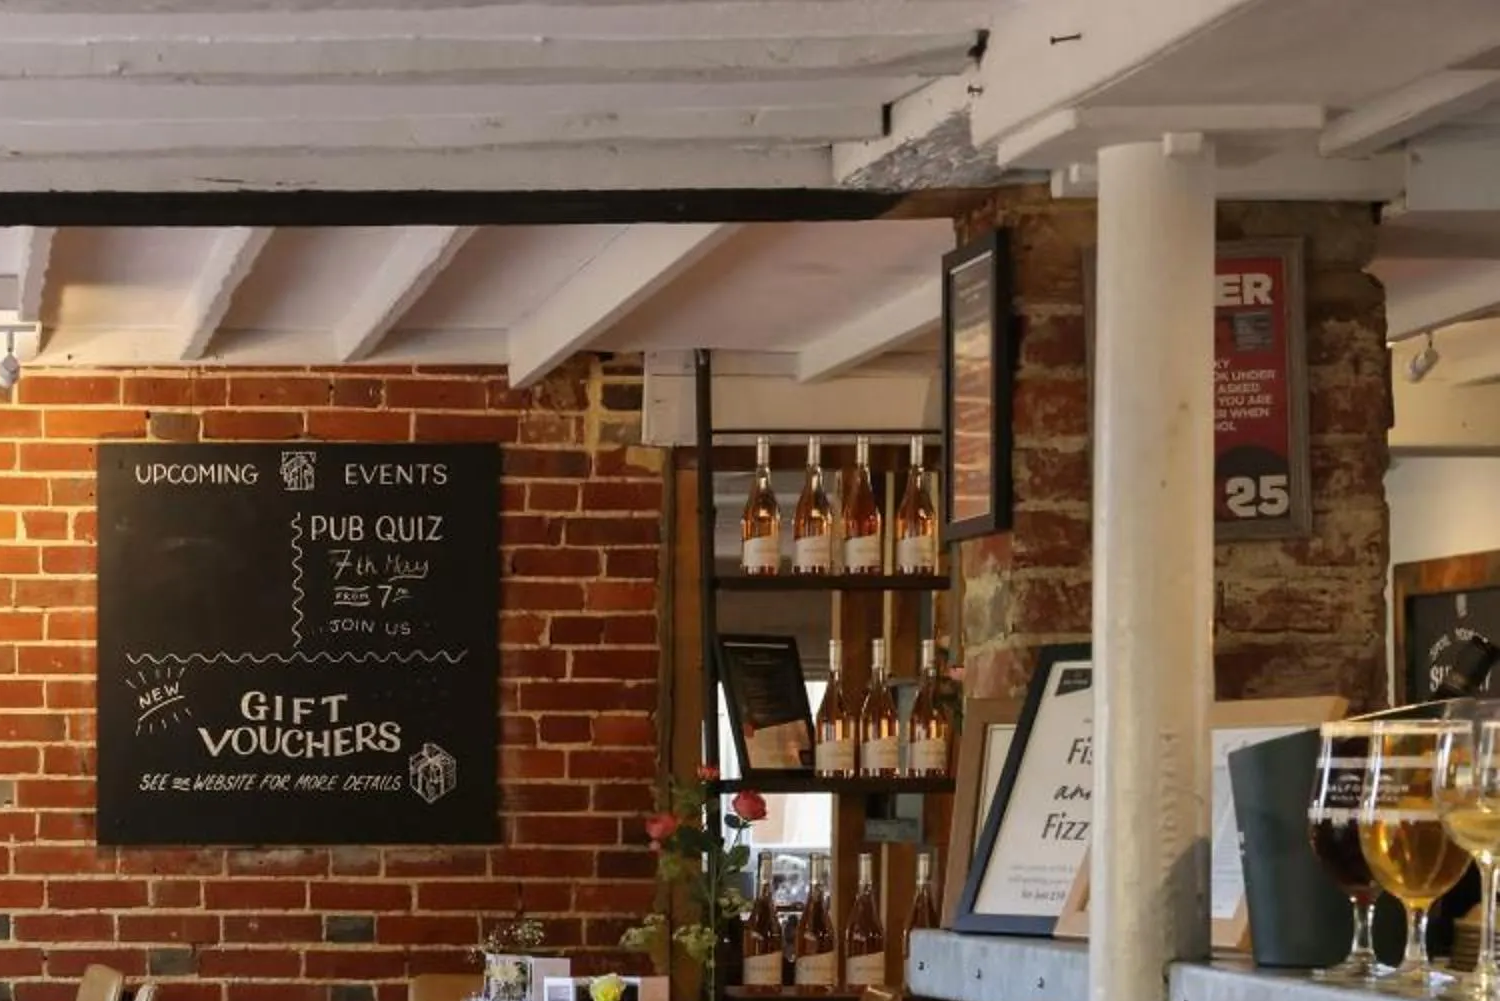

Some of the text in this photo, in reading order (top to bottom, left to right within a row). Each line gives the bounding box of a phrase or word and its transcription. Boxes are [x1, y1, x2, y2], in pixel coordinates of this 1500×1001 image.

[135, 463, 448, 486] UPCOMING EVENTS
[1225, 474, 1289, 517] 25
[311, 515, 444, 543] PUB QUIZ
[329, 618, 412, 635] JOIN US
[138, 681, 181, 709] NEW
[240, 691, 348, 725] GIFT
[198, 721, 401, 759] VOUCHERS
[139, 773, 171, 791] SEE
[192, 773, 257, 791] WEBSITE
[259, 774, 290, 791] FOR
[294, 774, 339, 791] MORE
[343, 774, 402, 791] DETAILS
[1041, 812, 1092, 841] Fizz
